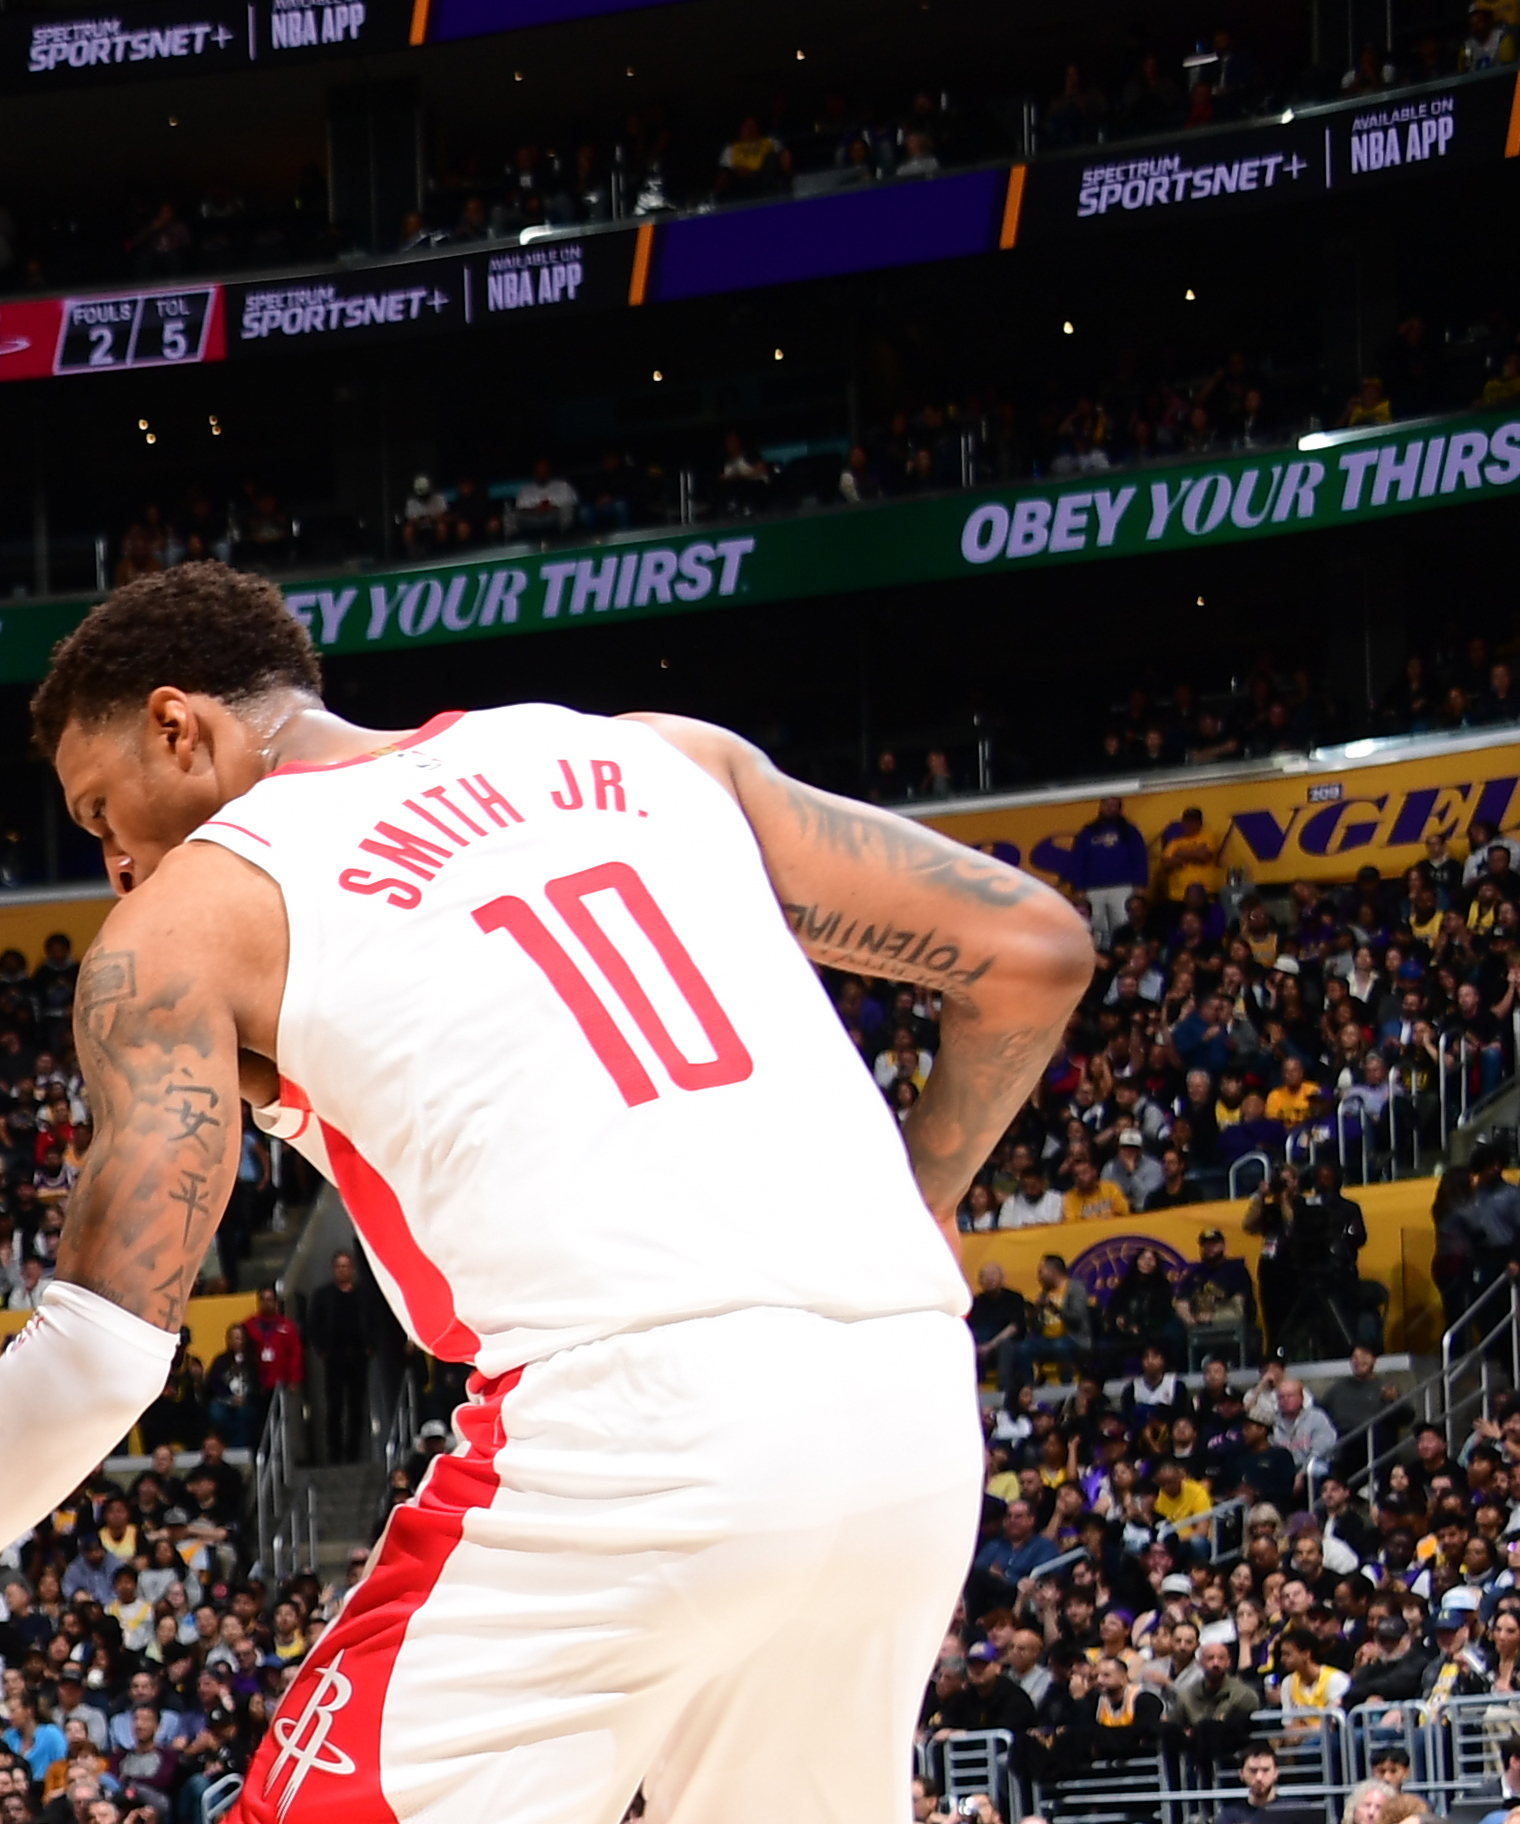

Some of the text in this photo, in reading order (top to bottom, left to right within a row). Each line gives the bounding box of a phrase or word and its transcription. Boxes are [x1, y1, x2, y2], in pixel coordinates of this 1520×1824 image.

[28, 24, 234, 72] SPORTSNET+
[32, 19, 122, 45] SPECTRUM
[271, 5, 366, 50] NBA APP
[1350, 98, 1454, 132] AVAILABLE ON
[1350, 116, 1454, 175] NBA APP
[1077, 158, 1309, 218] SPORTSNET+
[1082, 156, 1181, 188] SPECTRUM
[489, 246, 582, 272] AVAILABLE ON
[155, 299, 190, 318] TOL
[246, 286, 336, 314] SPECTRUM
[488, 262, 584, 312] NBA APP
[74, 302, 131, 325] FOULS
[241, 291, 449, 340] SPORTSNET+
[89, 329, 114, 366] 2
[162, 321, 186, 359] 5
[961, 421, 1520, 565] OBEY YOUR THIRS
[366, 570, 529, 641] YOUR
[540, 536, 755, 619] THIRST
[339, 758, 649, 910] SMITH JR.
[470, 861, 754, 1109] 10
